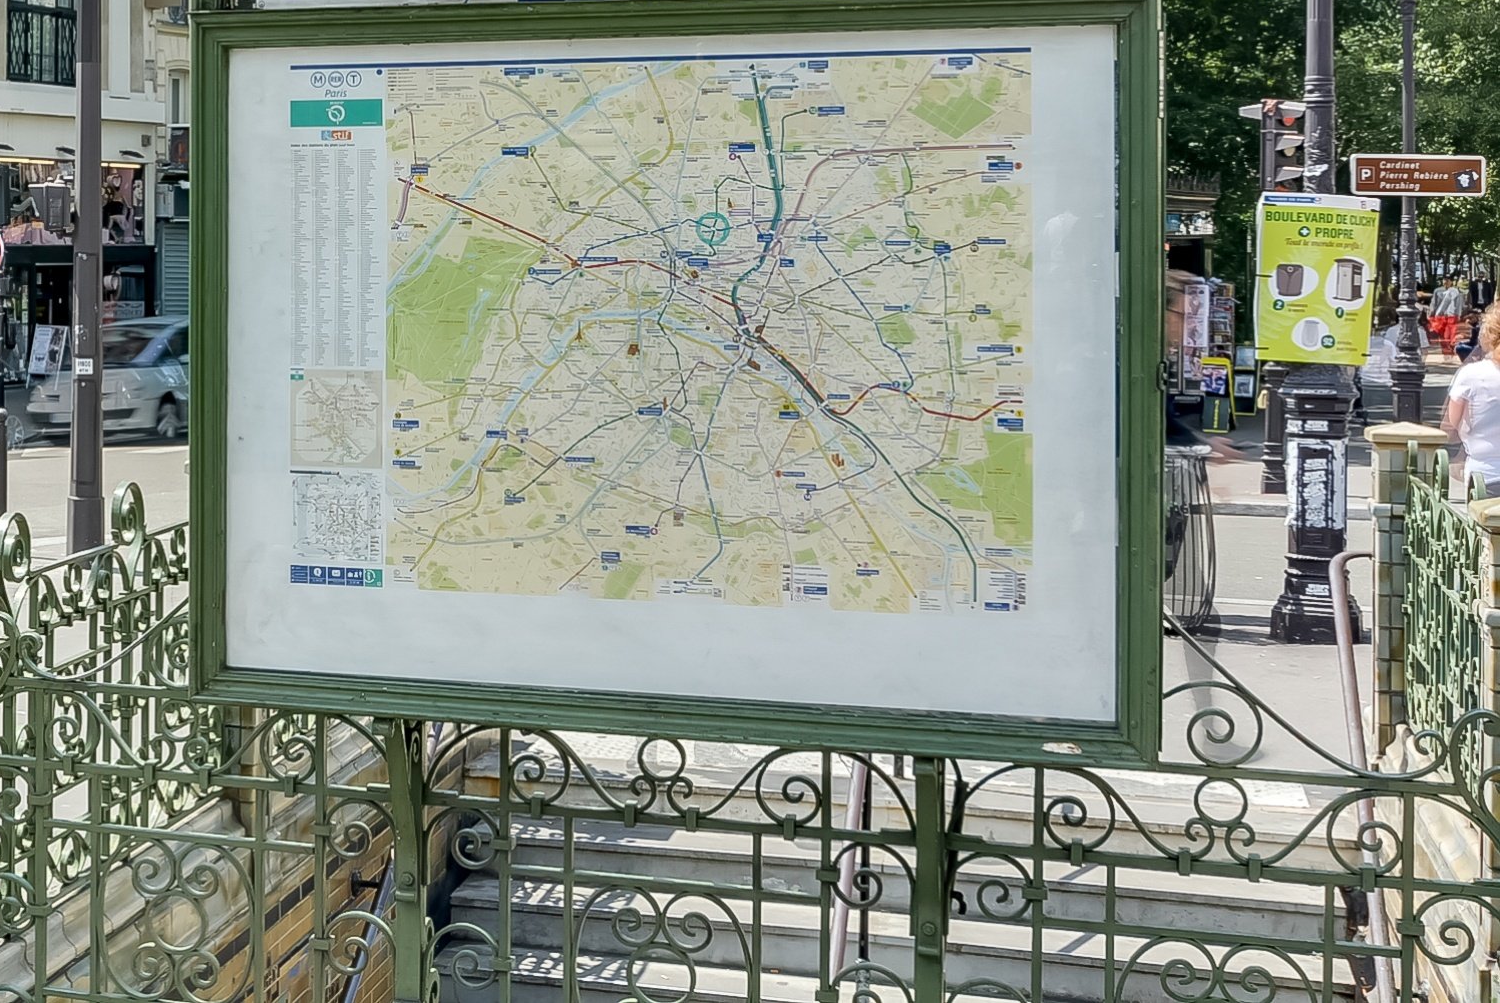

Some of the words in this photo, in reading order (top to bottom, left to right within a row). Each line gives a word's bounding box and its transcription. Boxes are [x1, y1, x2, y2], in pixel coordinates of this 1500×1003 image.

[324, 89, 348, 98] Paris
[1380, 161, 1420, 169] Cardinet
[1380, 171, 1408, 180] Pierre
[1380, 182, 1421, 191] Pershing
[1265, 211, 1333, 224] BOULEVARD
[1336, 214, 1348, 225] DE
[1349, 215, 1376, 228] CLICHY
[1315, 227, 1354, 240] PROPRE
